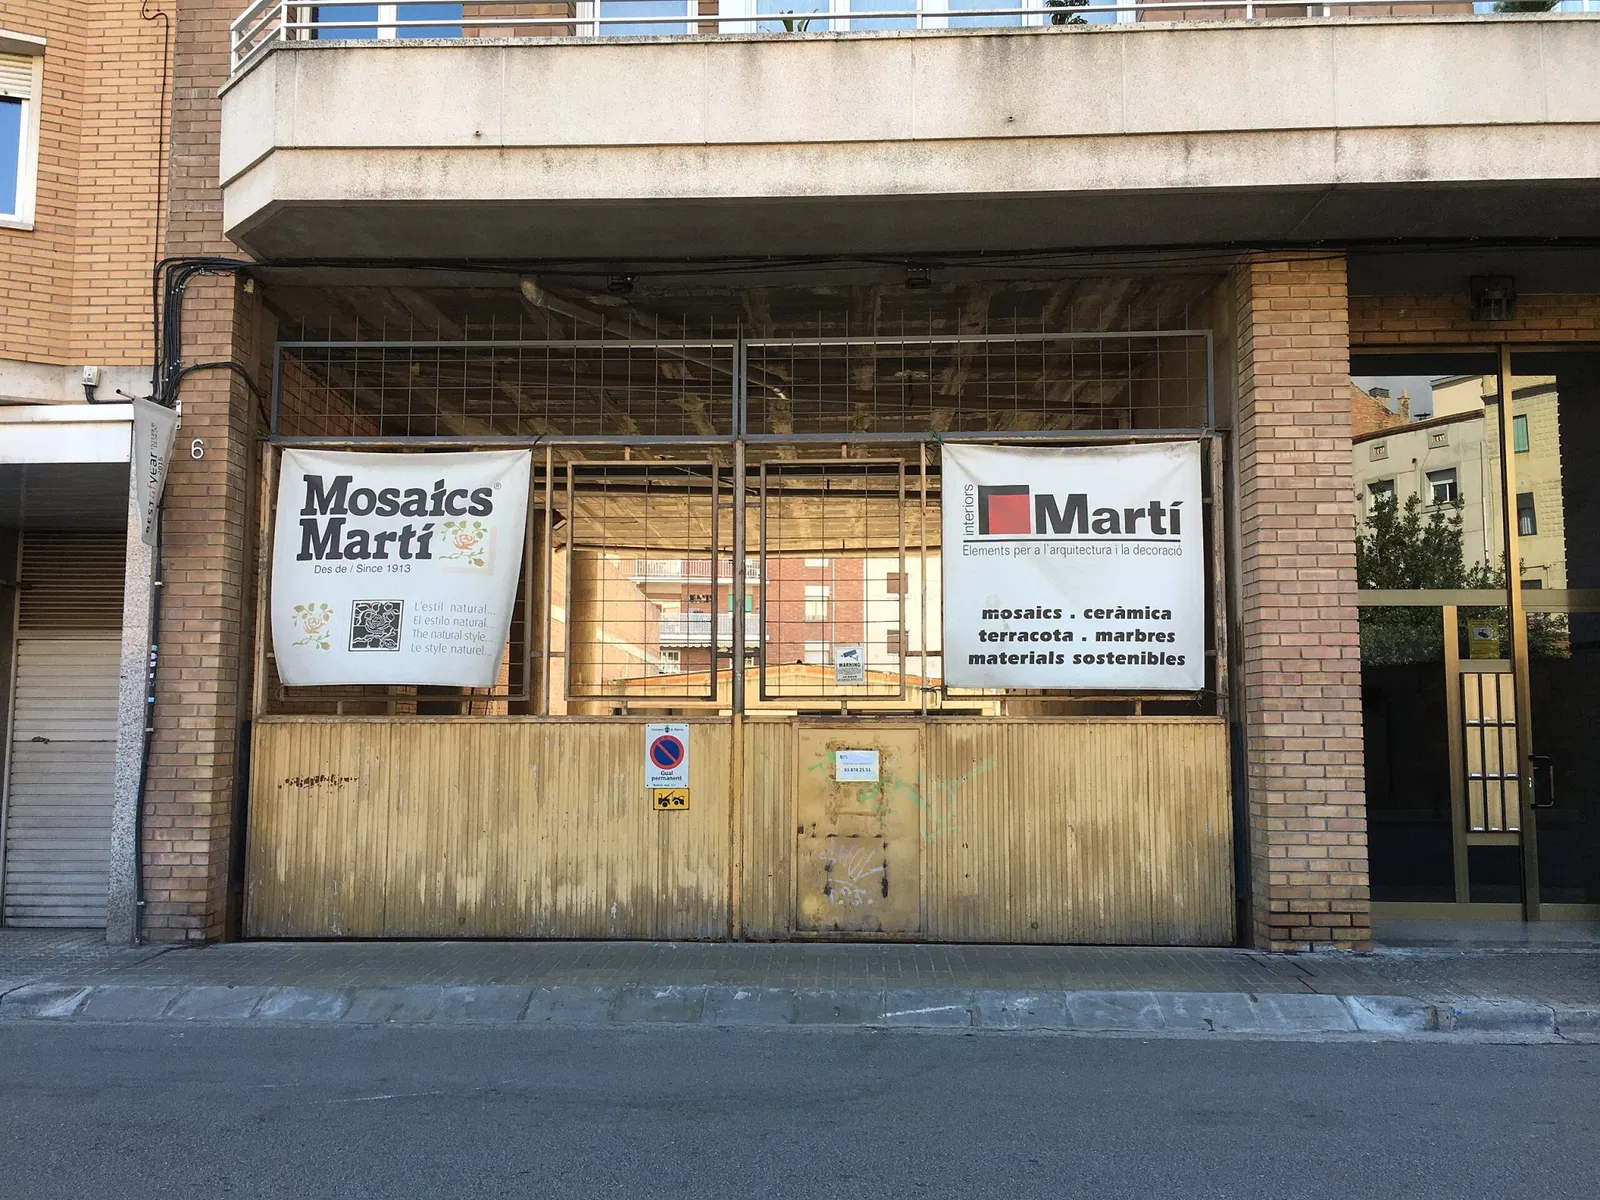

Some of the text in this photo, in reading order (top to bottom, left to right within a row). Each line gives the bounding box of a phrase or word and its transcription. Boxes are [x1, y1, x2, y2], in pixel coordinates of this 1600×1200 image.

[191, 439, 204, 459] 6
[300, 474, 493, 517] Mosaics
[963, 484, 974, 536] interiors
[1034, 493, 1184, 535] Martí
[296, 517, 435, 561] Martí
[963, 544, 1011, 556] Elements
[1014, 547, 1031, 558] per
[1034, 547, 1041, 556] a
[1043, 544, 1113, 558] l'arquitectura
[1121, 544, 1130, 556] la
[1133, 545, 1183, 556] decoració
[314, 564, 333, 574] Des
[335, 564, 347, 574] de
[356, 564, 383, 574] Since
[387, 564, 411, 574] 1913
[414, 601, 444, 612] L'estil
[982, 606, 1062, 620] mosaics
[1083, 606, 1172, 620] ceràmica
[413, 615, 421, 625] El
[424, 615, 450, 626] estilo
[412, 628, 429, 639] The
[430, 629, 462, 640] natural
[979, 629, 1074, 643] terracota
[1095, 629, 1176, 643] marbres
[411, 643, 421, 653] Le
[424, 643, 448, 655] style
[968, 651, 1186, 666] materials sostenibles
[651, 775, 683, 783] permanent
